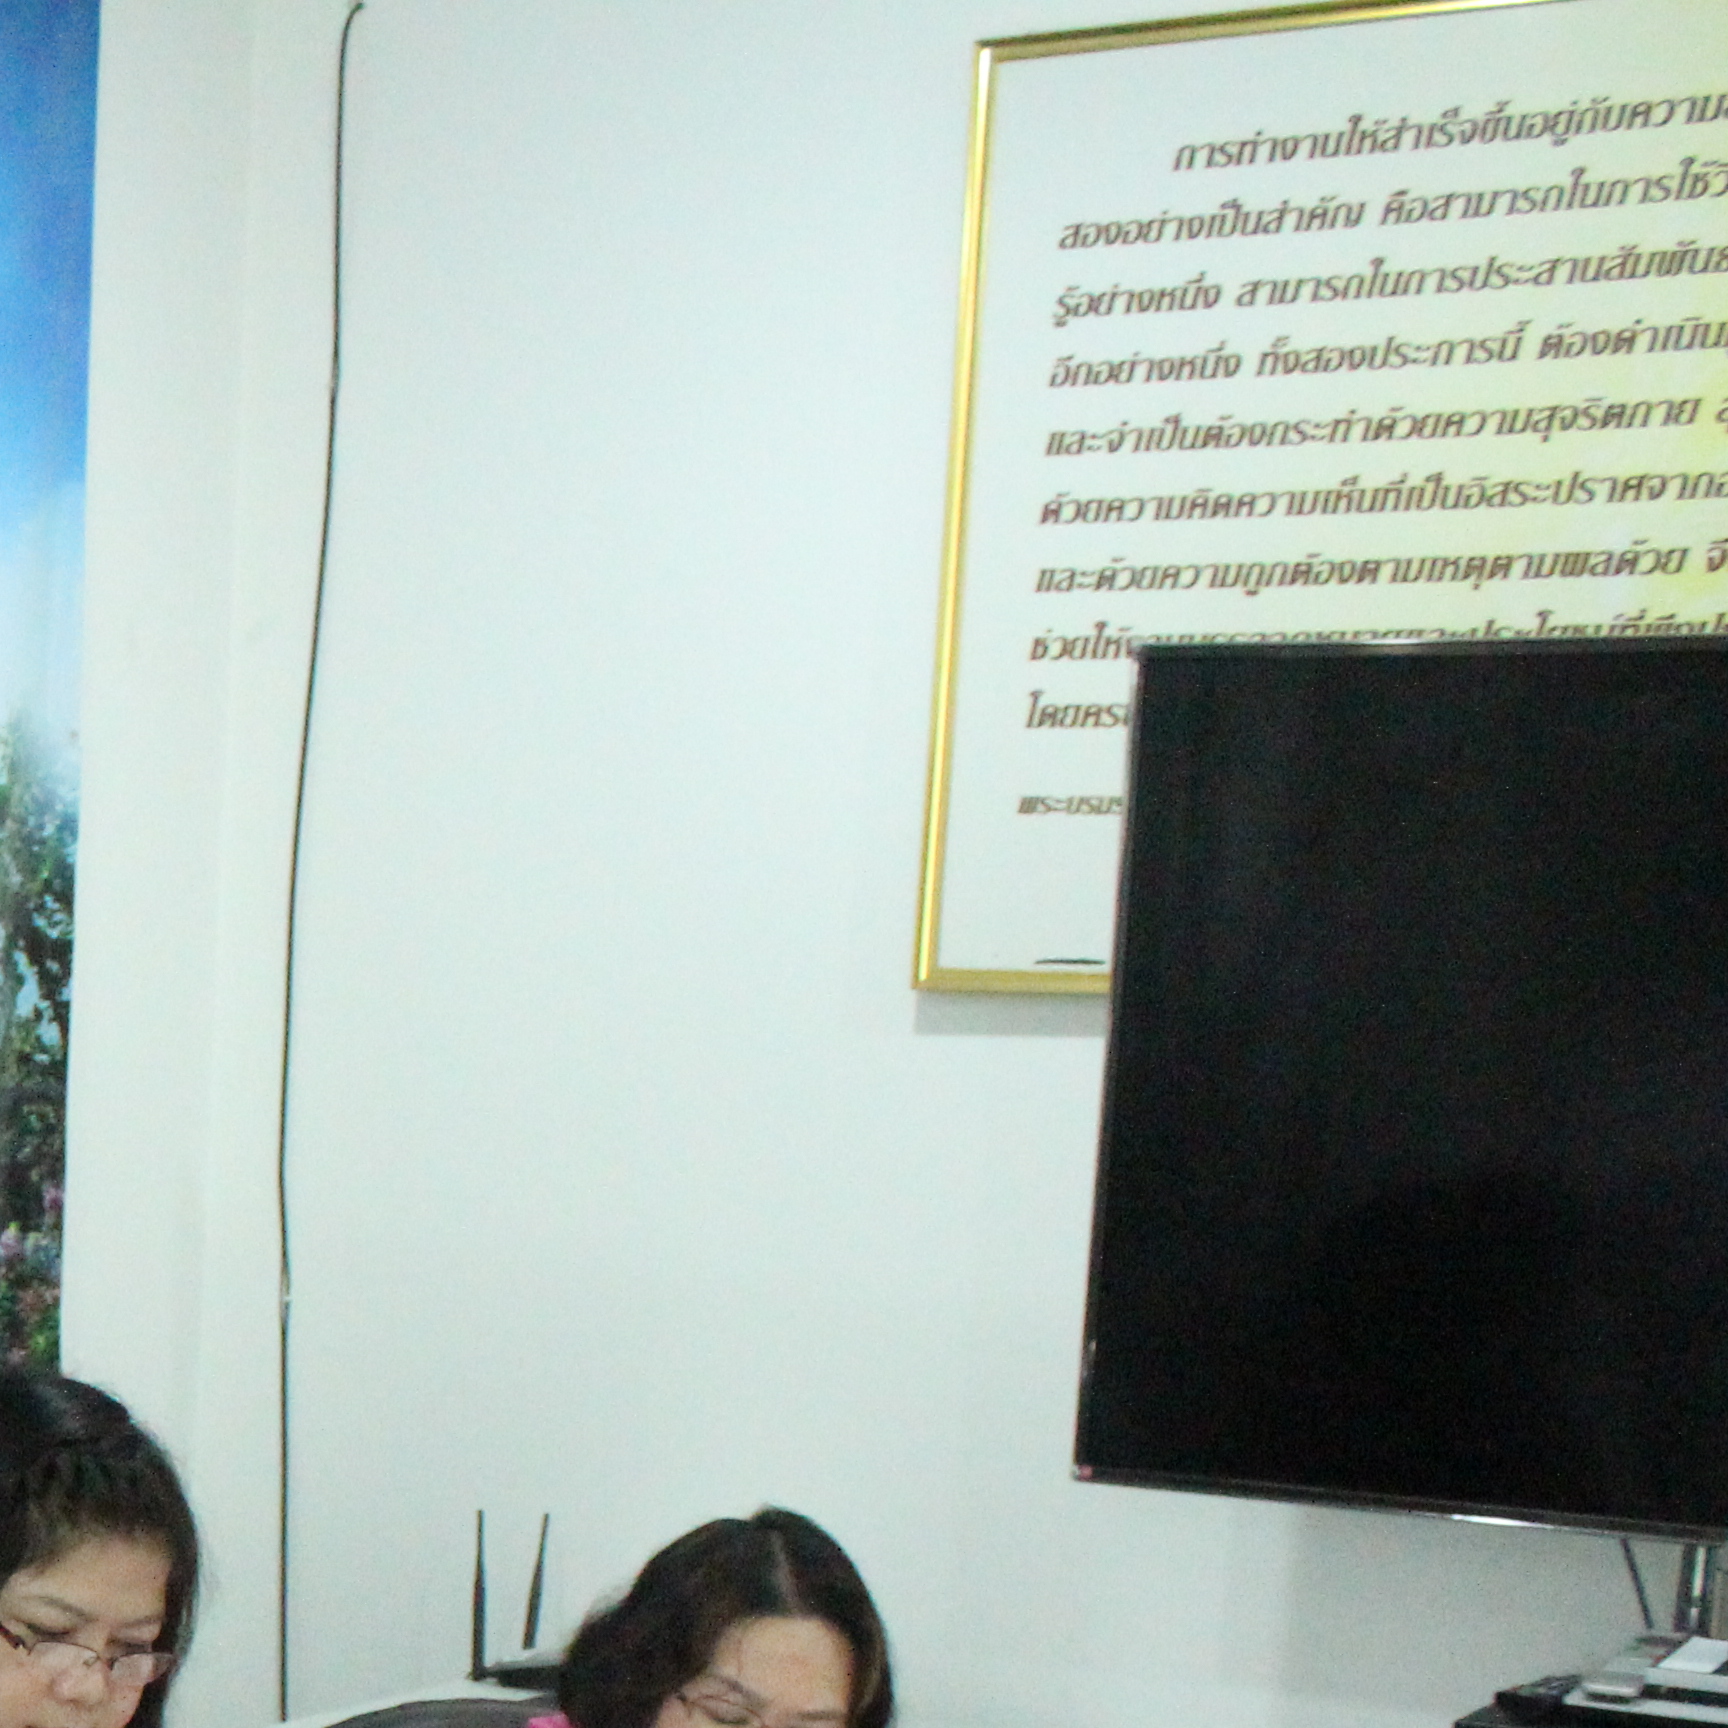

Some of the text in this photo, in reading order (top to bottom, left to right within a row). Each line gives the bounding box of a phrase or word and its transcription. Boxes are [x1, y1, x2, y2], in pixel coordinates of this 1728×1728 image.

[1172, 93, 1728, 172] การทำงานให้สำเร็จขึ้นอยู่กับความ
[1057, 195, 1367, 250] สองอย่างเป็นสำคัญ
[1052, 270, 1223, 327] รู้อย่างหนึ่ง
[1048, 340, 1243, 388] อีกอย่างหนึ่ง
[1255, 319, 1533, 377] ทั้งสองประการนี้
[1025, 689, 1130, 729] โดยคร
